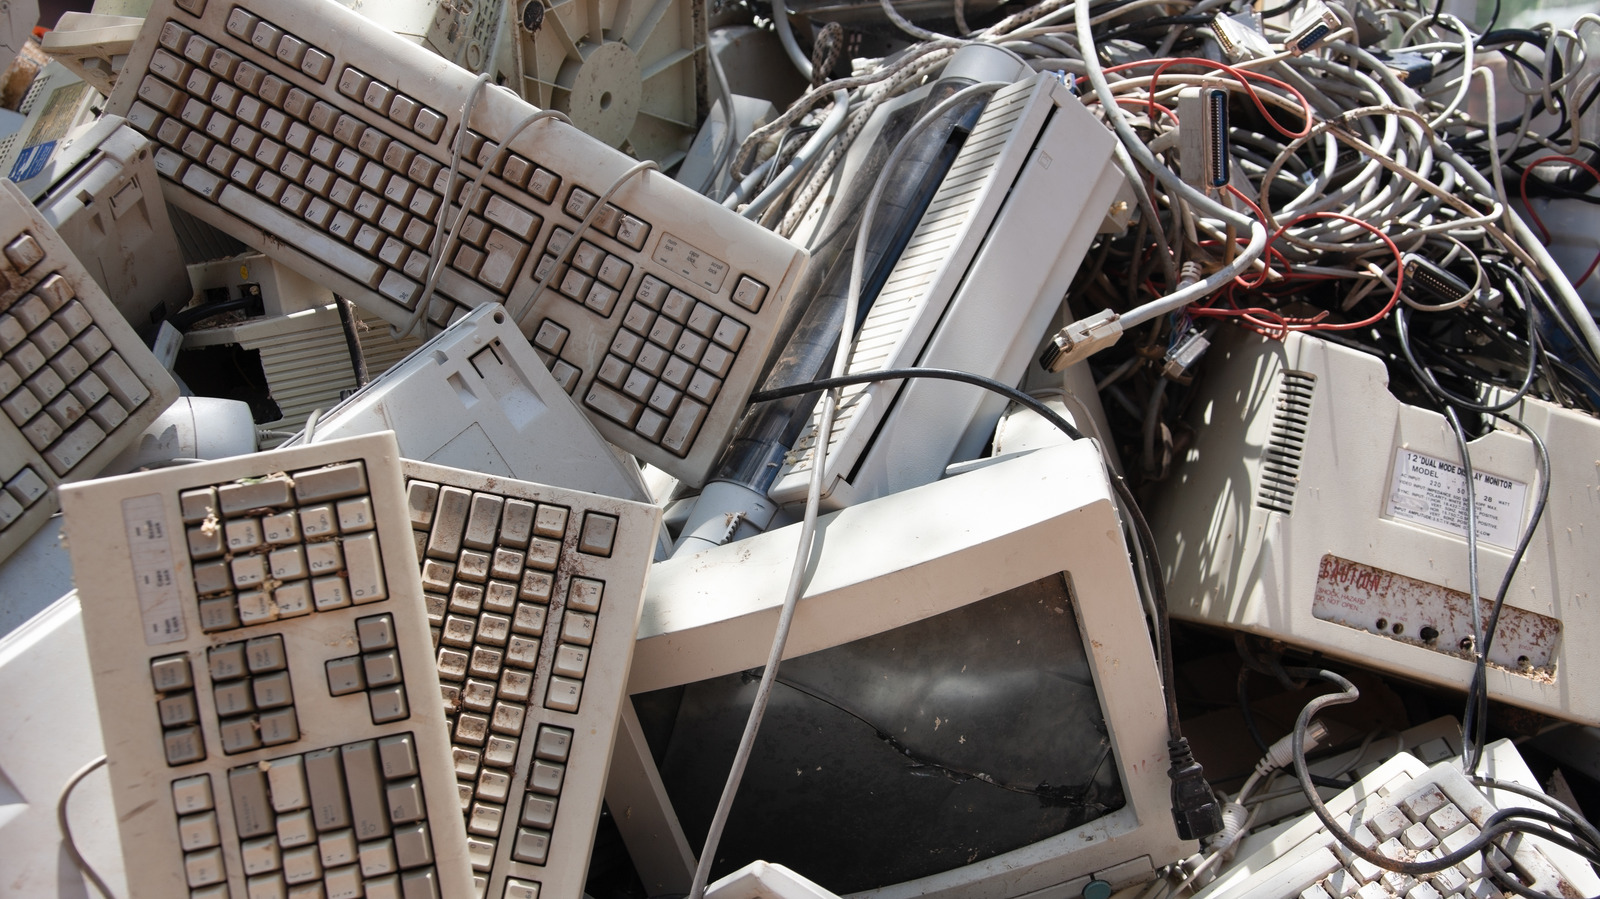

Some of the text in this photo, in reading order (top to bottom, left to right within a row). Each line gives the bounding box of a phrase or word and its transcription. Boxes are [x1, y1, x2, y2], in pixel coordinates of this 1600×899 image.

[663, 244, 675, 252] lock
[666, 238, 678, 247] num
[710, 261, 724, 271] scroll
[1412, 465, 1439, 478] MODEL
[1438, 462, 1456, 474] MODE
[1484, 475, 1513, 490] MONITOR
[1483, 495, 1493, 503] 28
[155, 522, 163, 539] Lock
[156, 570, 164, 587] Caps
[163, 569, 171, 586] Lock
[1317, 587, 1367, 605] SHOCK HAZARD
[1327, 597, 1340, 606] NOT
[171, 616, 180, 633] Lock
